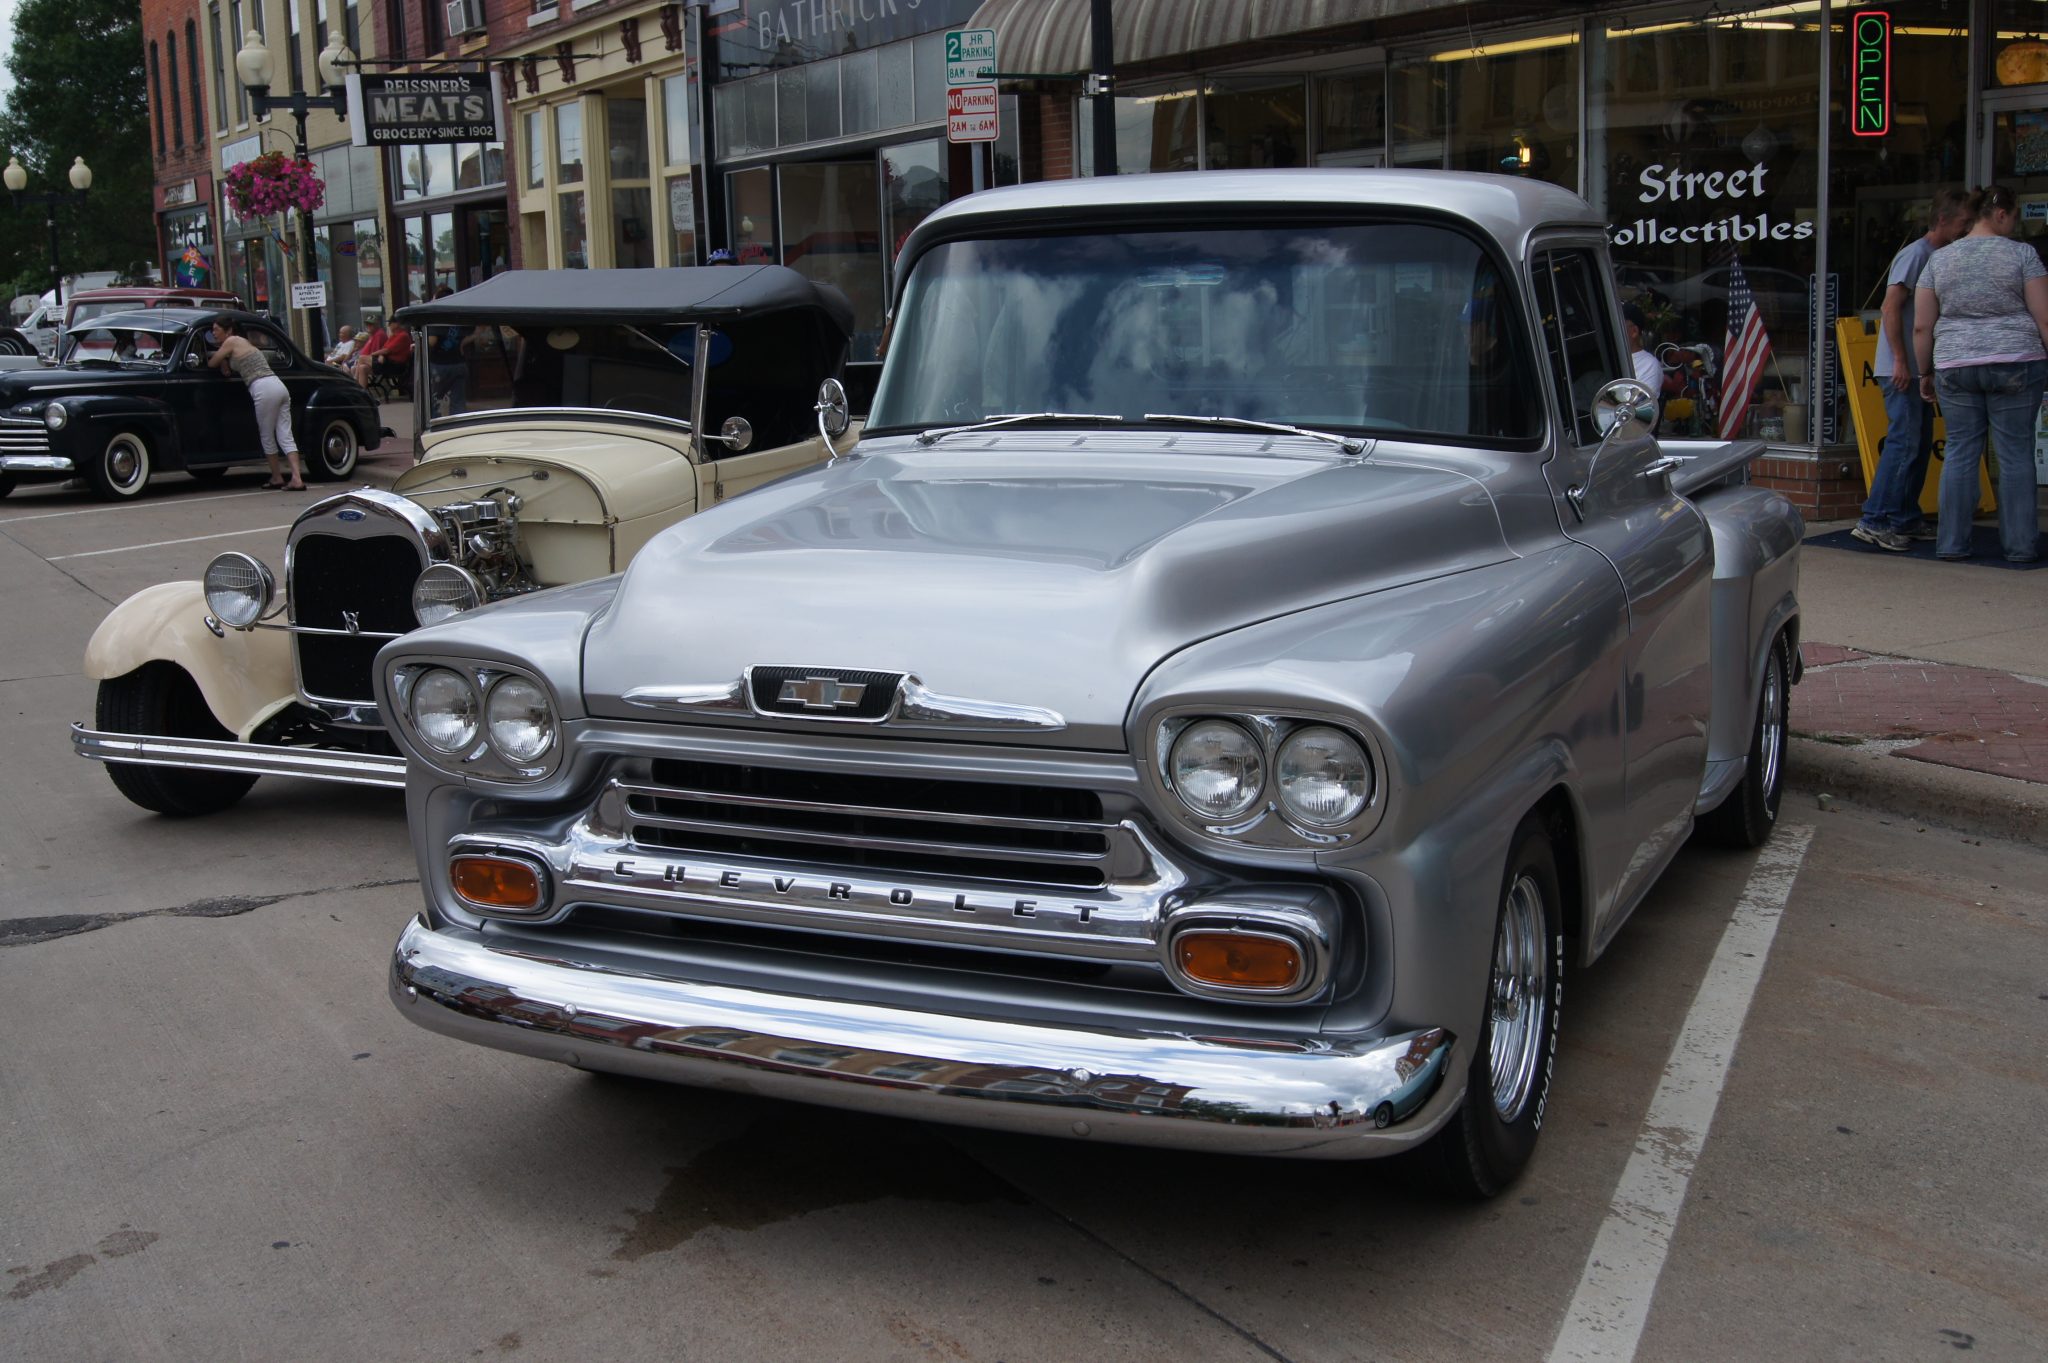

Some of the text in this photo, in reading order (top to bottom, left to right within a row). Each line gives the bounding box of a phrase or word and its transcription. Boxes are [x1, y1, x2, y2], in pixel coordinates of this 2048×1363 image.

[948, 34, 983, 59] 2 HR
[962, 46, 993, 58] PARKING
[384, 77, 471, 93] REISSNER'S
[949, 67, 965, 78] 8AM
[1859, 19, 1883, 128] OPEN
[373, 95, 484, 122] MEATS
[948, 94, 994, 110] NO PARKING
[373, 126, 494, 140] GROCERY SINCE 1902
[951, 121, 967, 132] 2AM
[979, 121, 995, 132] 6AM
[1639, 160, 1769, 203] Street
[1605, 213, 1813, 246] ollectibles
[188, 250, 198, 287] OPEN
[613, 859, 1100, 924] CHEVROLET
